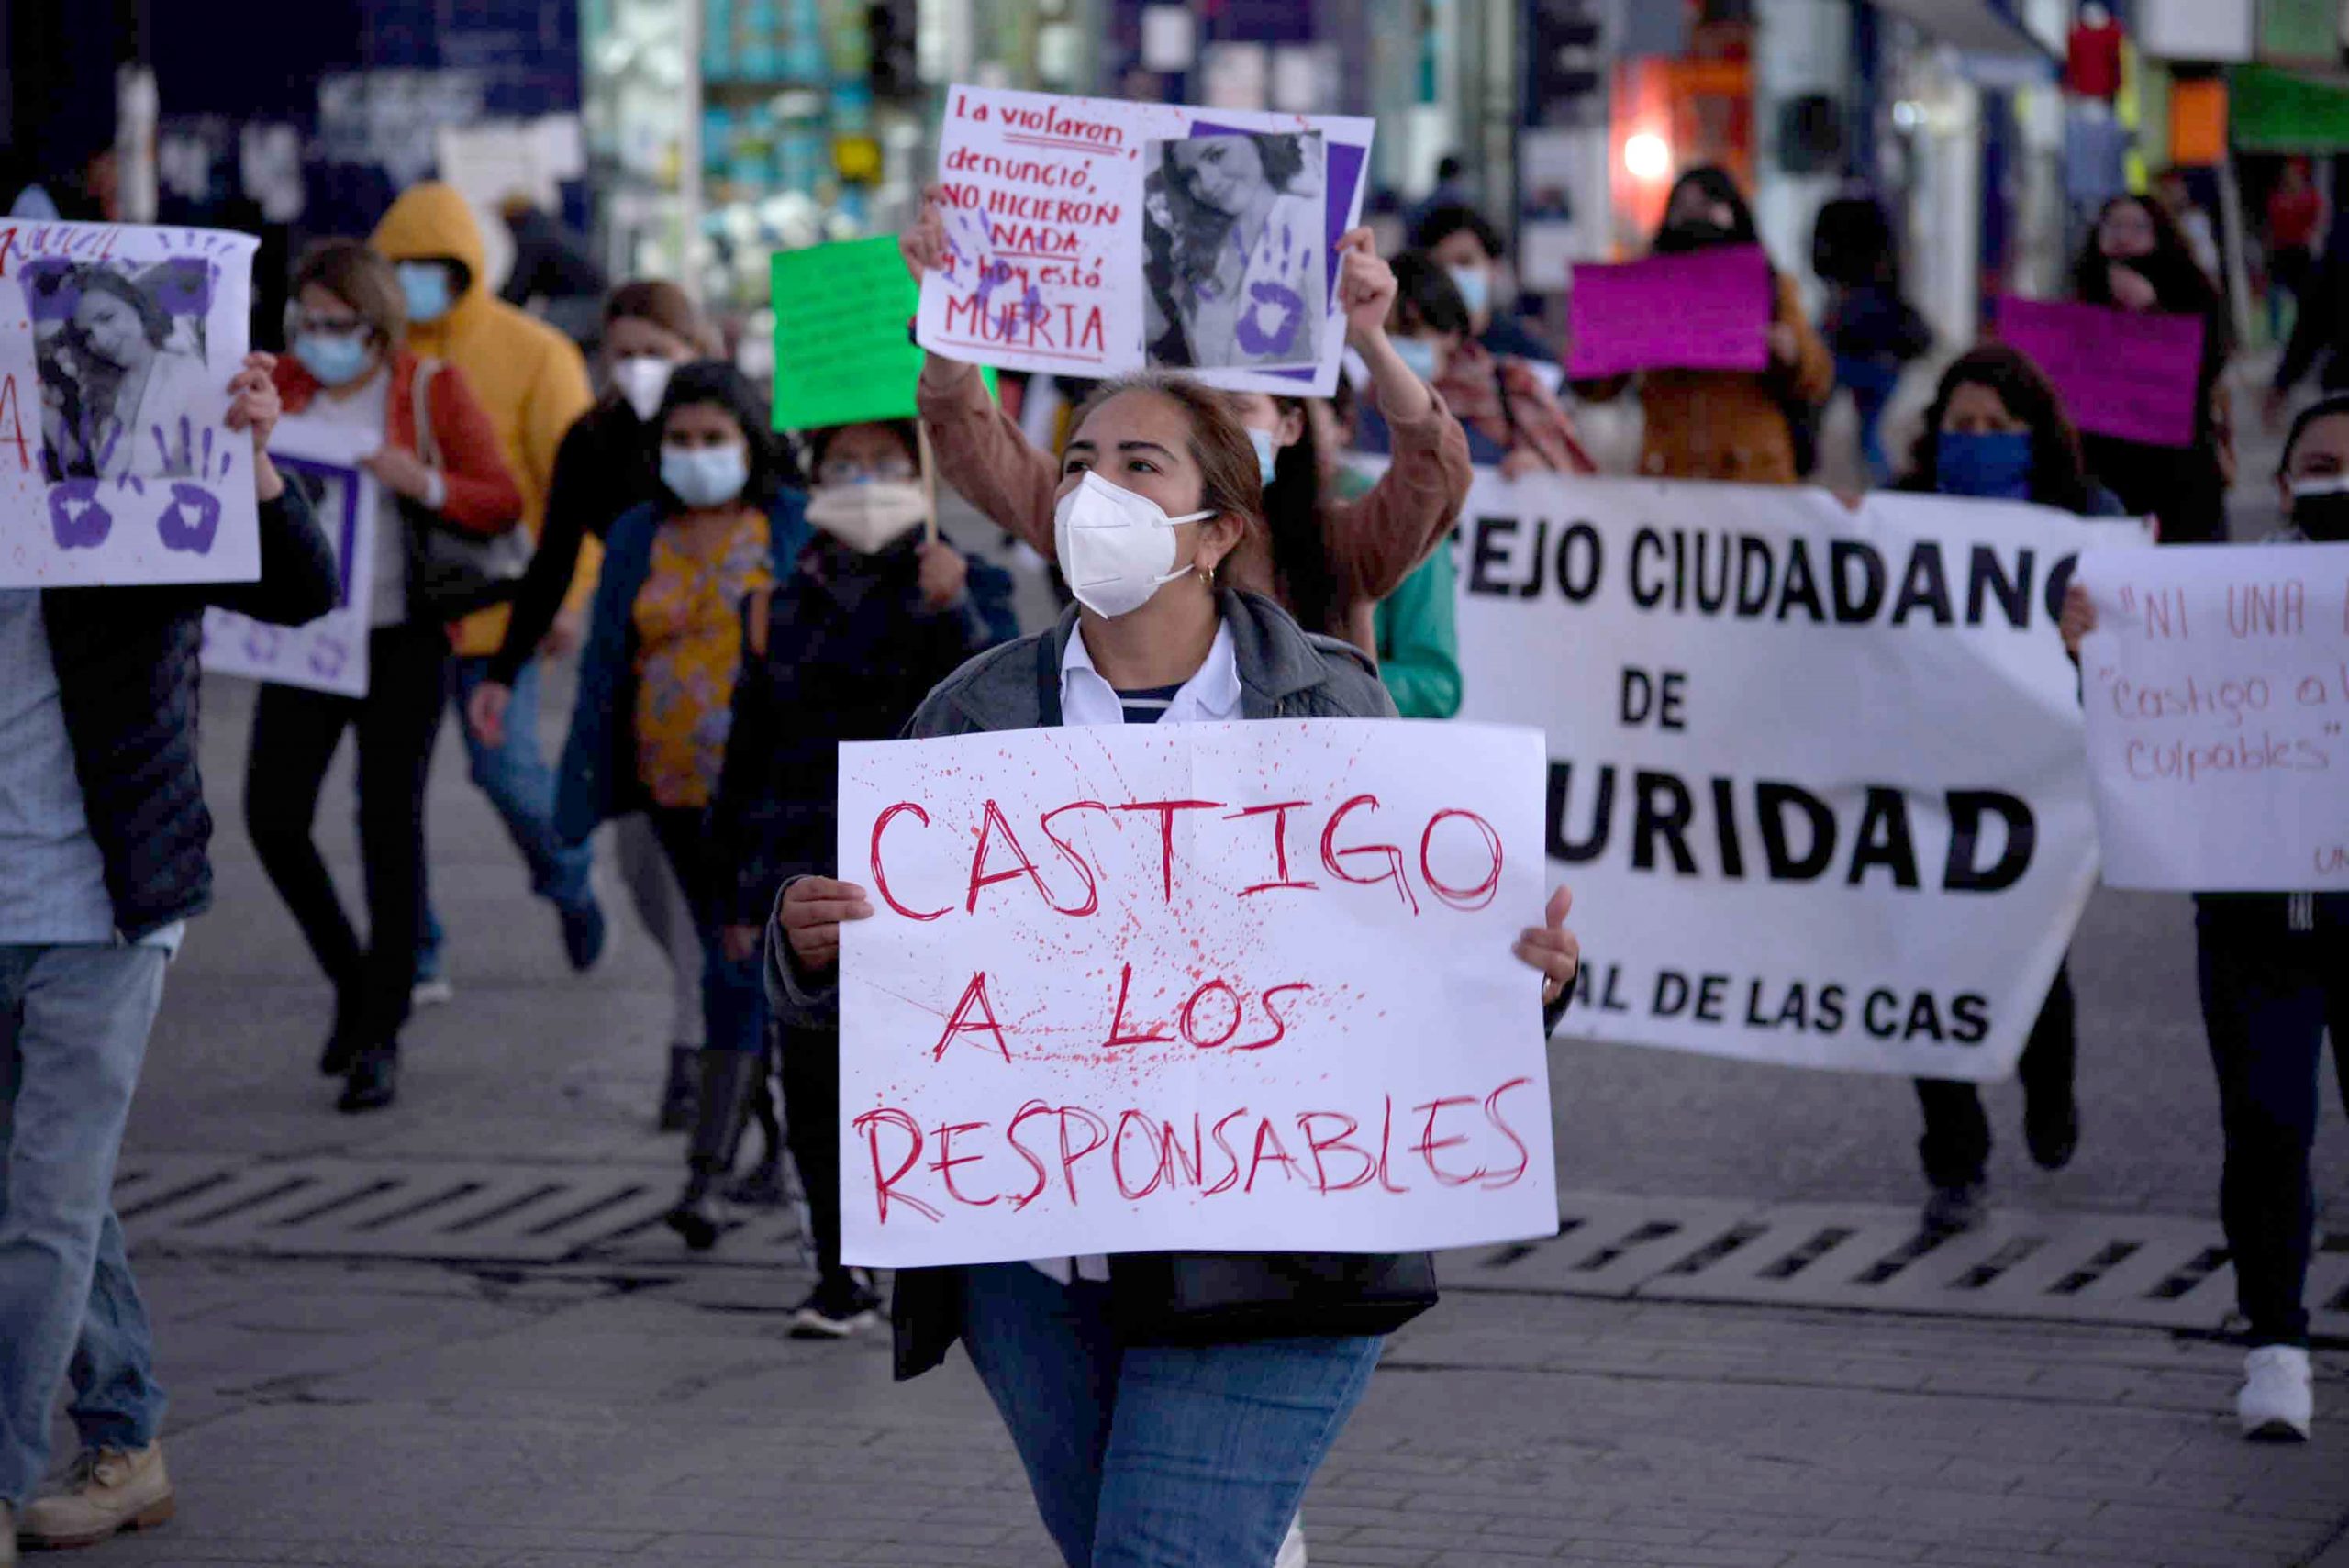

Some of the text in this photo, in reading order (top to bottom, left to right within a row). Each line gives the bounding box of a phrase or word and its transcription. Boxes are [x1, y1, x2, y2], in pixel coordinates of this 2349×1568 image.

[941, 183, 1121, 225] NO HICIERON
[991, 222, 1078, 253] NADA
[978, 254, 1029, 295] hoy
[1039, 257, 1101, 287] está
[945, 293, 1105, 352] MUERTA
[1450, 517, 1602, 606] EJO
[2226, 579, 2305, 639] UNA
[1620, 666, 1687, 733] DE
[869, 793, 1505, 922] CASTIGO
[1546, 761, 2038, 895] URIDAD
[932, 962, 1312, 1064] A LOS
[1651, 970, 1730, 1023] DE
[1744, 977, 1847, 1036] LAS
[1862, 986, 1992, 1047] CAS
[852, 1076, 1533, 1225] RESPONSABLES
